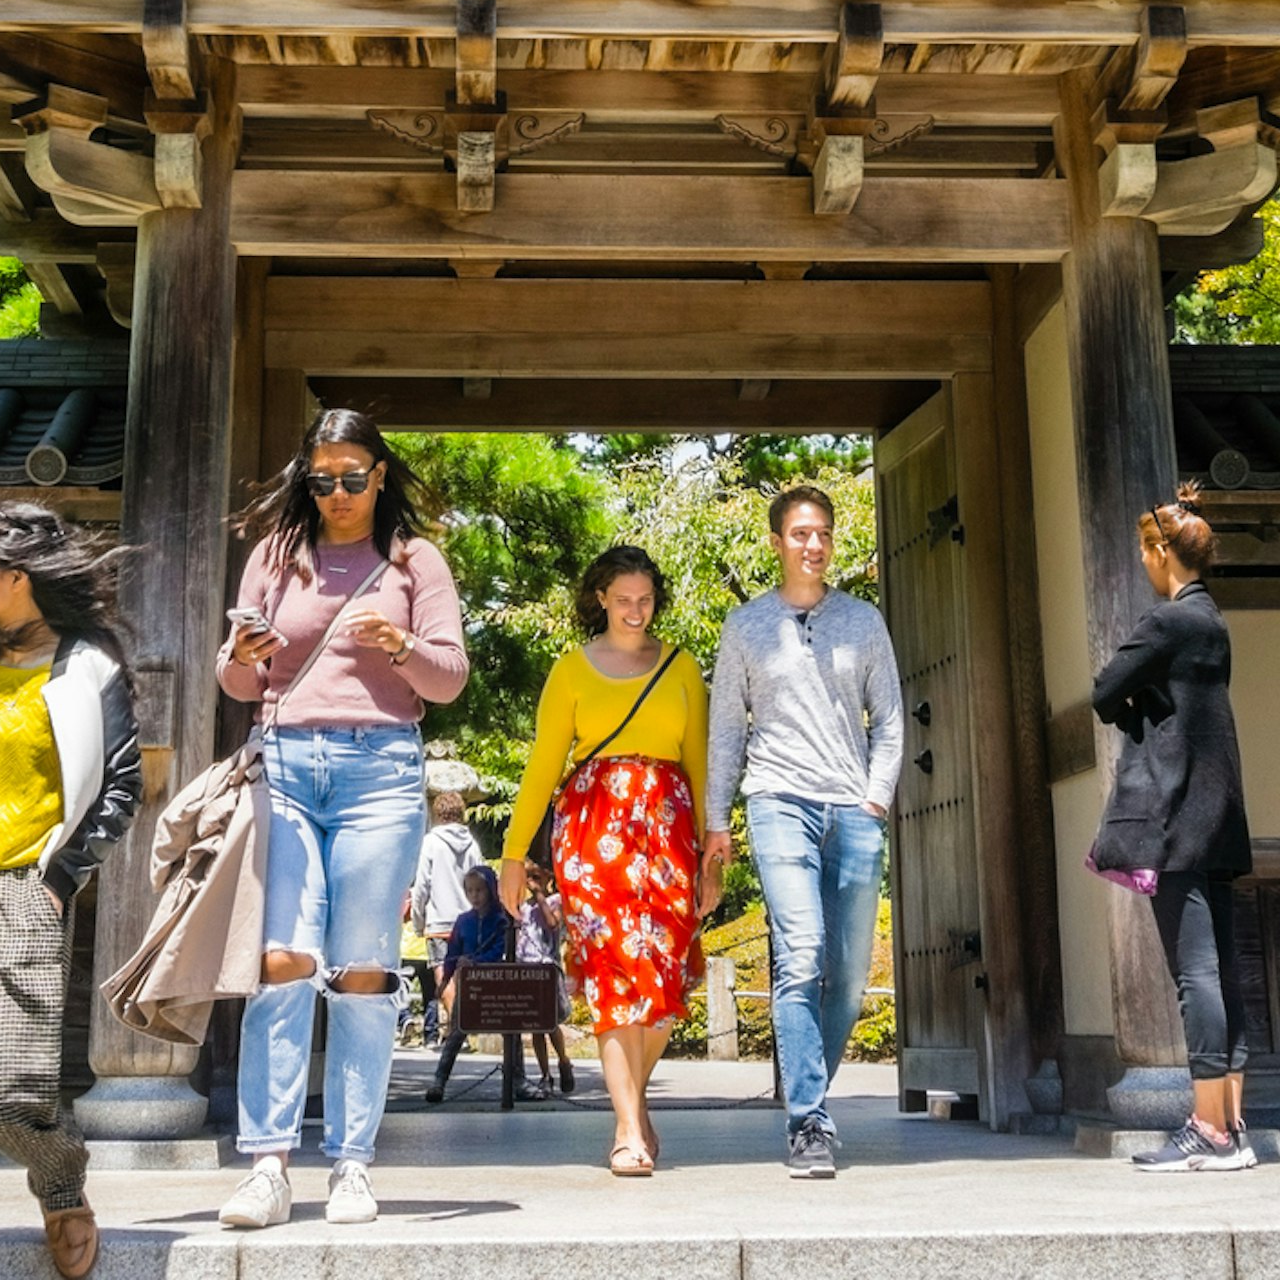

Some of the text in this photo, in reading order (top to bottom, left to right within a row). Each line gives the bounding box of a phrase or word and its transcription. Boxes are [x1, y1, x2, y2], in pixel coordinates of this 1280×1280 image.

[466, 969, 550, 980] JAPANESE TEA GARDEN
